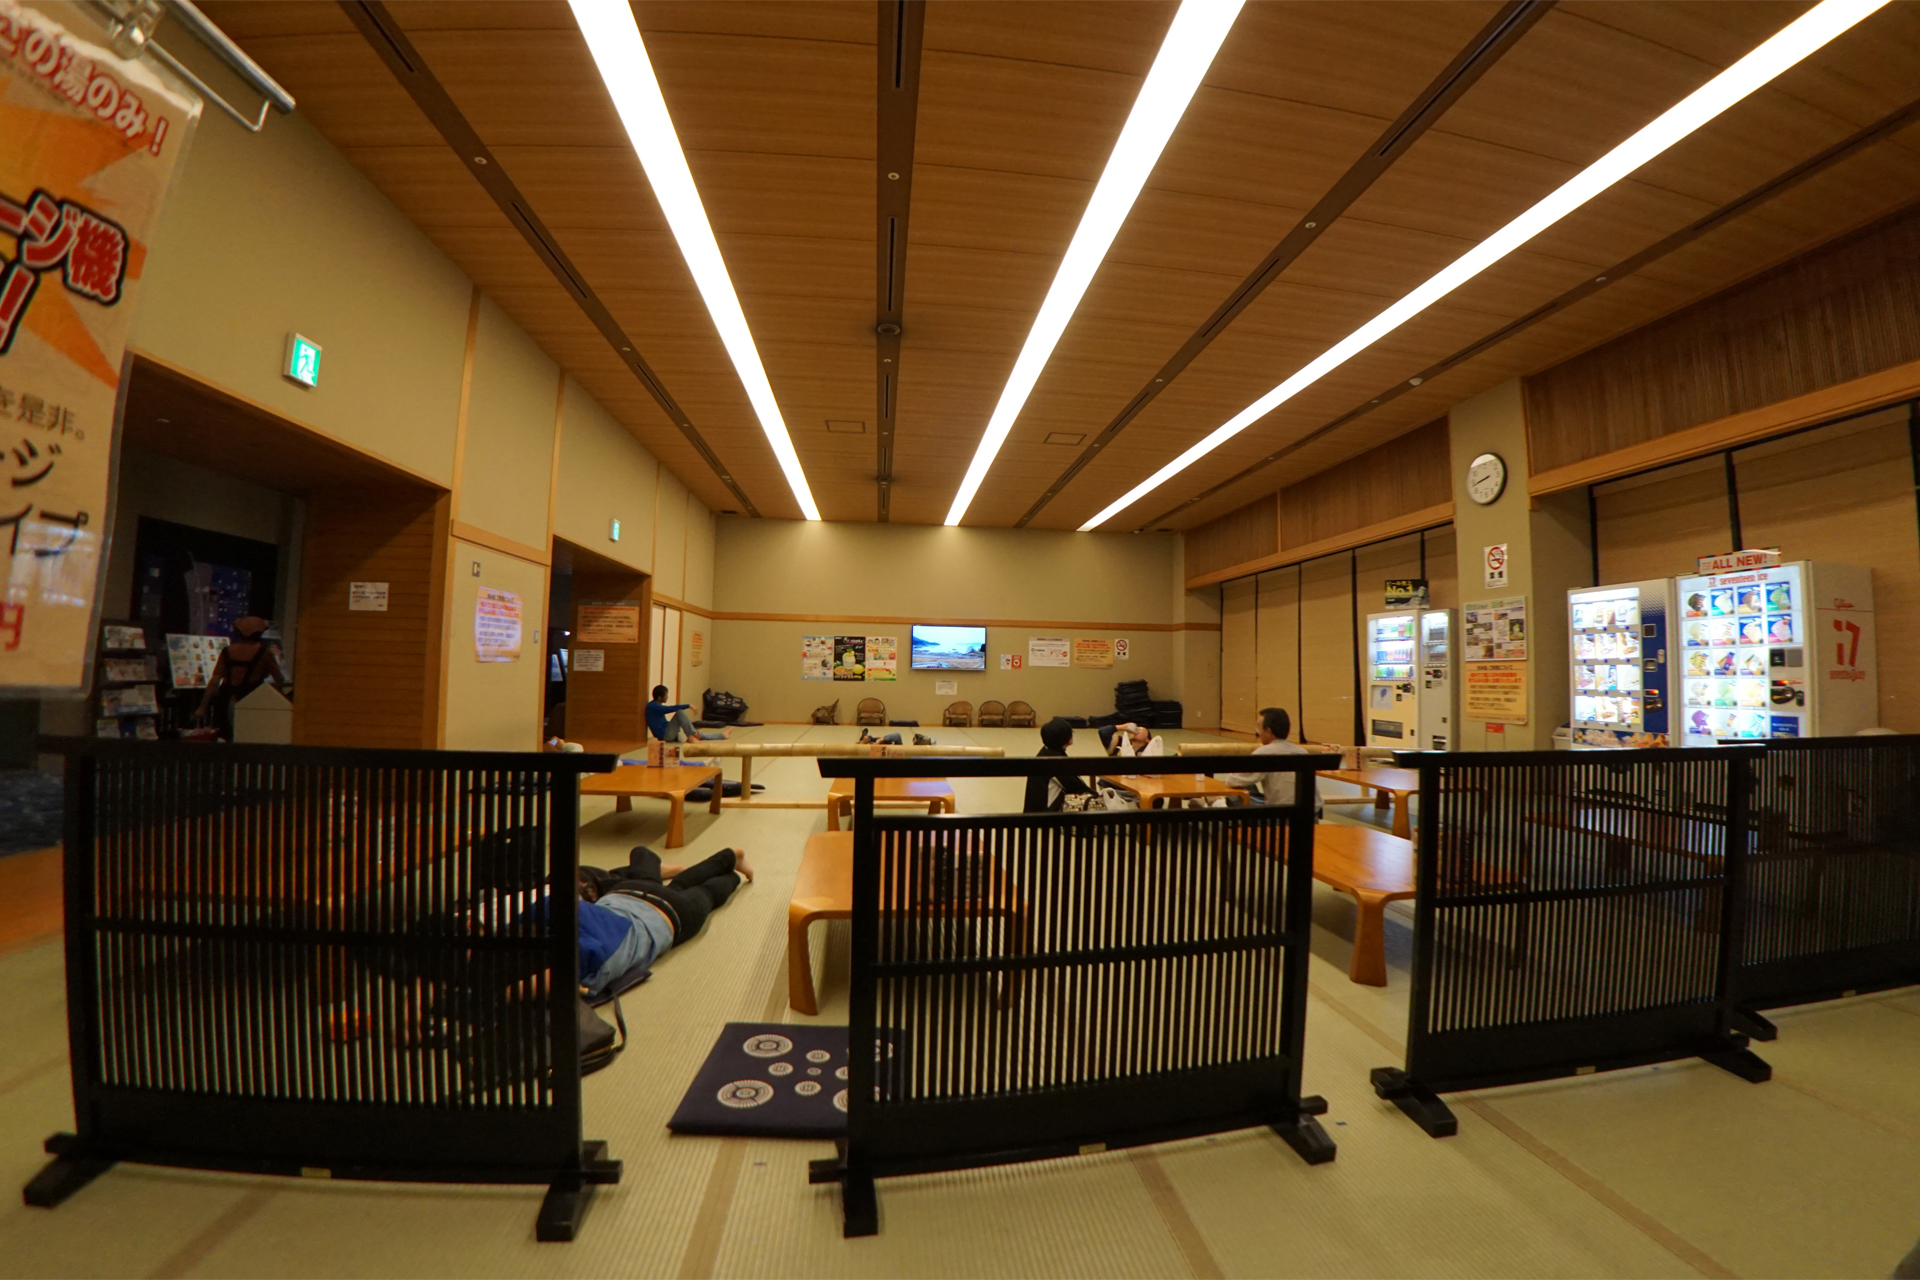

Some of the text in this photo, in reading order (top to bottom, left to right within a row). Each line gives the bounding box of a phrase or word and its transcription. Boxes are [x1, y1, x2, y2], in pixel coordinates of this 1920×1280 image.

[0, 438, 62, 487] ジ
[1712, 553, 1768, 570] ALL NEW!
[1719, 574, 1756, 585] seventeen
[1757, 570, 1768, 581] ice
